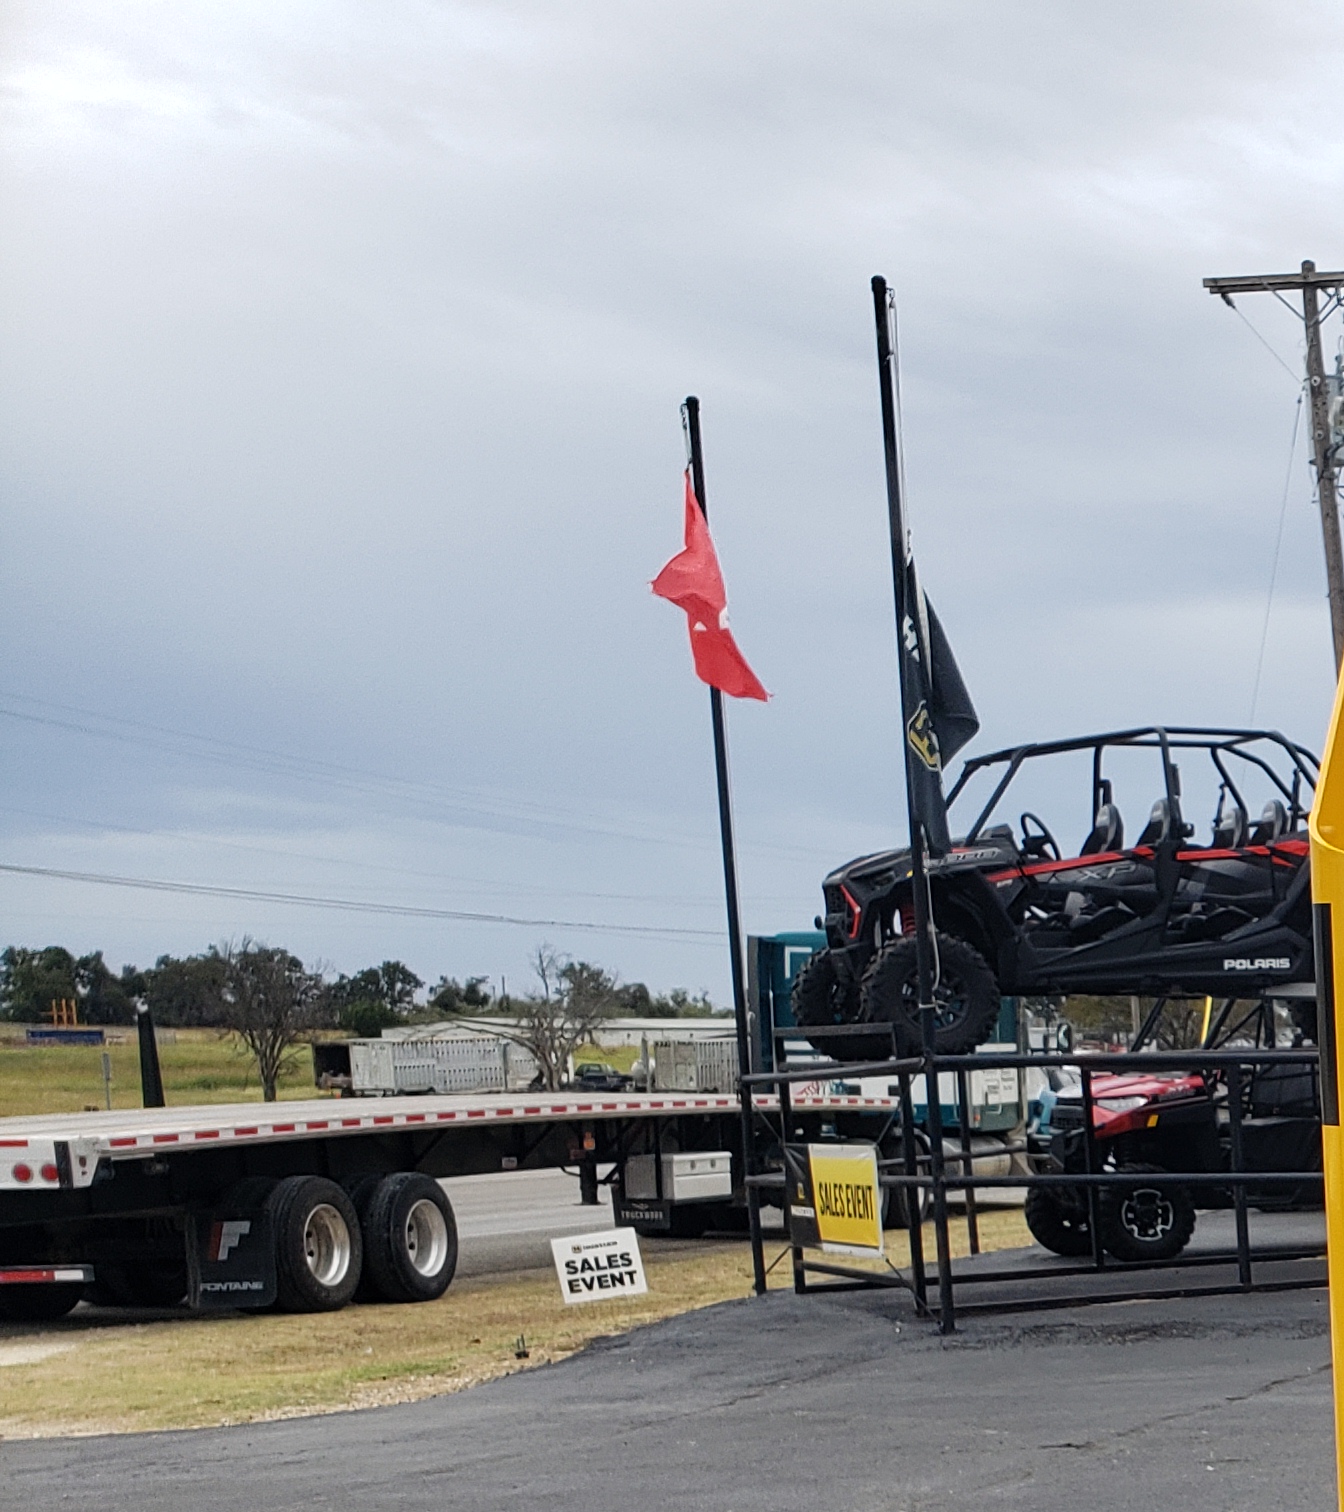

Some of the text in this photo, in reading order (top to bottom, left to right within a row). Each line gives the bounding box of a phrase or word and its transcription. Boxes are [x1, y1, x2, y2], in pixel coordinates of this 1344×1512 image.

[1223, 958, 1290, 970] POLARIS
[818, 1182, 874, 1221] SALES EVENT
[565, 1252, 633, 1275] SALES
[200, 1281, 264, 1291] FONTAINE
[567, 1270, 637, 1294] EVENT
